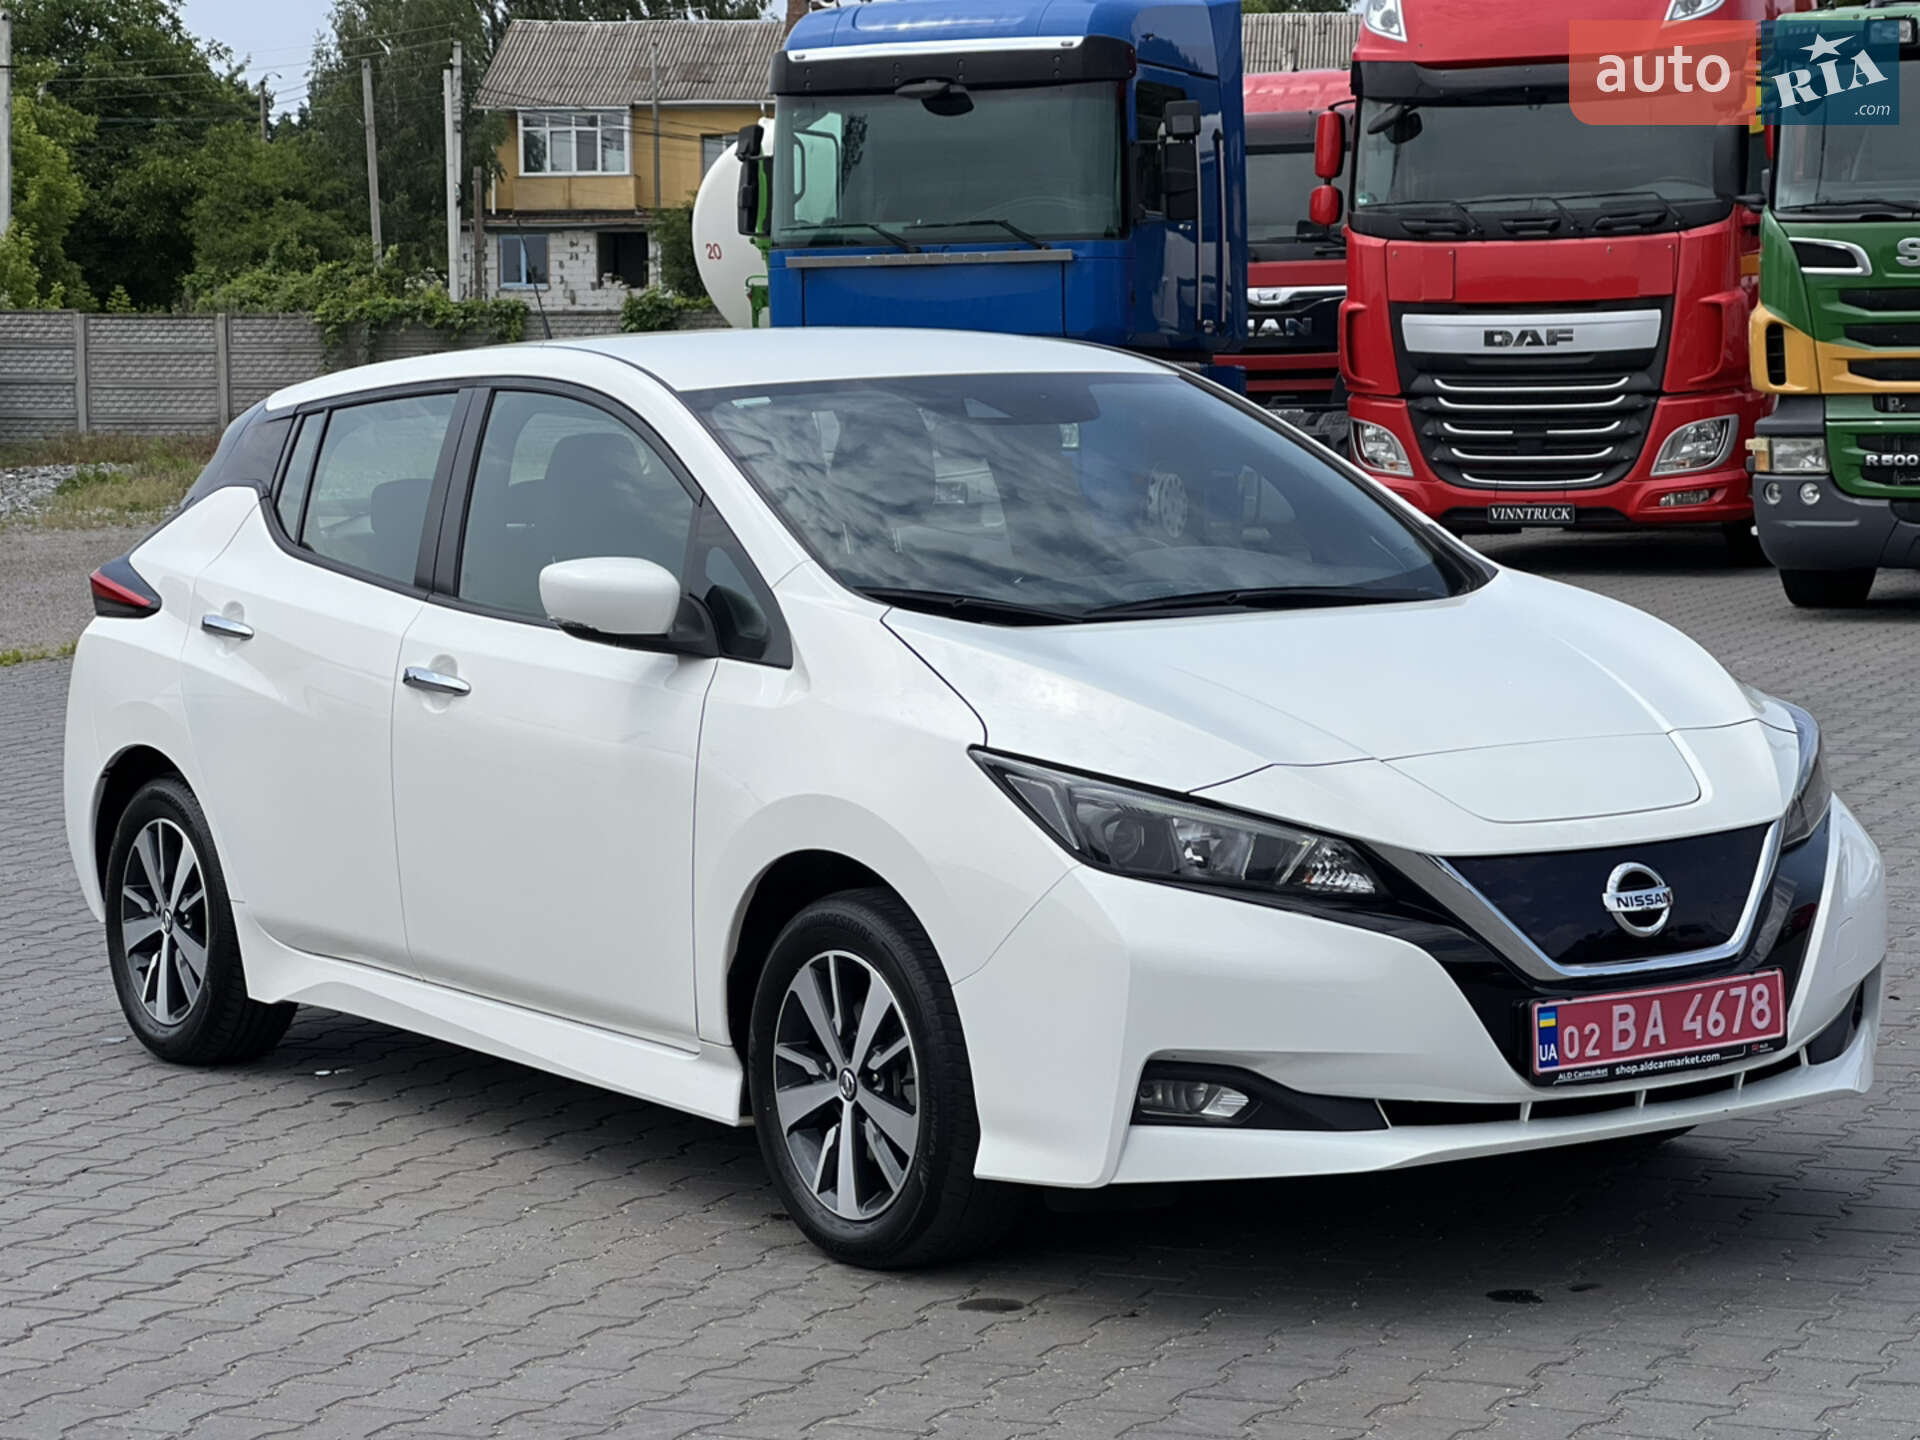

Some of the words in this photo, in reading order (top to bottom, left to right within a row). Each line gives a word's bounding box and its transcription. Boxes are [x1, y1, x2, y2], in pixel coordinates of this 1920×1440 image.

[705, 242, 722, 260] 20
[1247, 317, 1313, 337] AN
[1483, 328, 1574, 348] DAF
[1491, 506, 1571, 521] VINNTRUCK
[1615, 892, 1673, 908] NISSAN
[1563, 1022, 1601, 1060] 02
[1612, 1000, 1666, 1052] BA
[1682, 983, 1772, 1040] 4678
[1539, 1044, 1558, 1062] UA
[1615, 1052, 1721, 1076] shop.aldcarmarket.com
